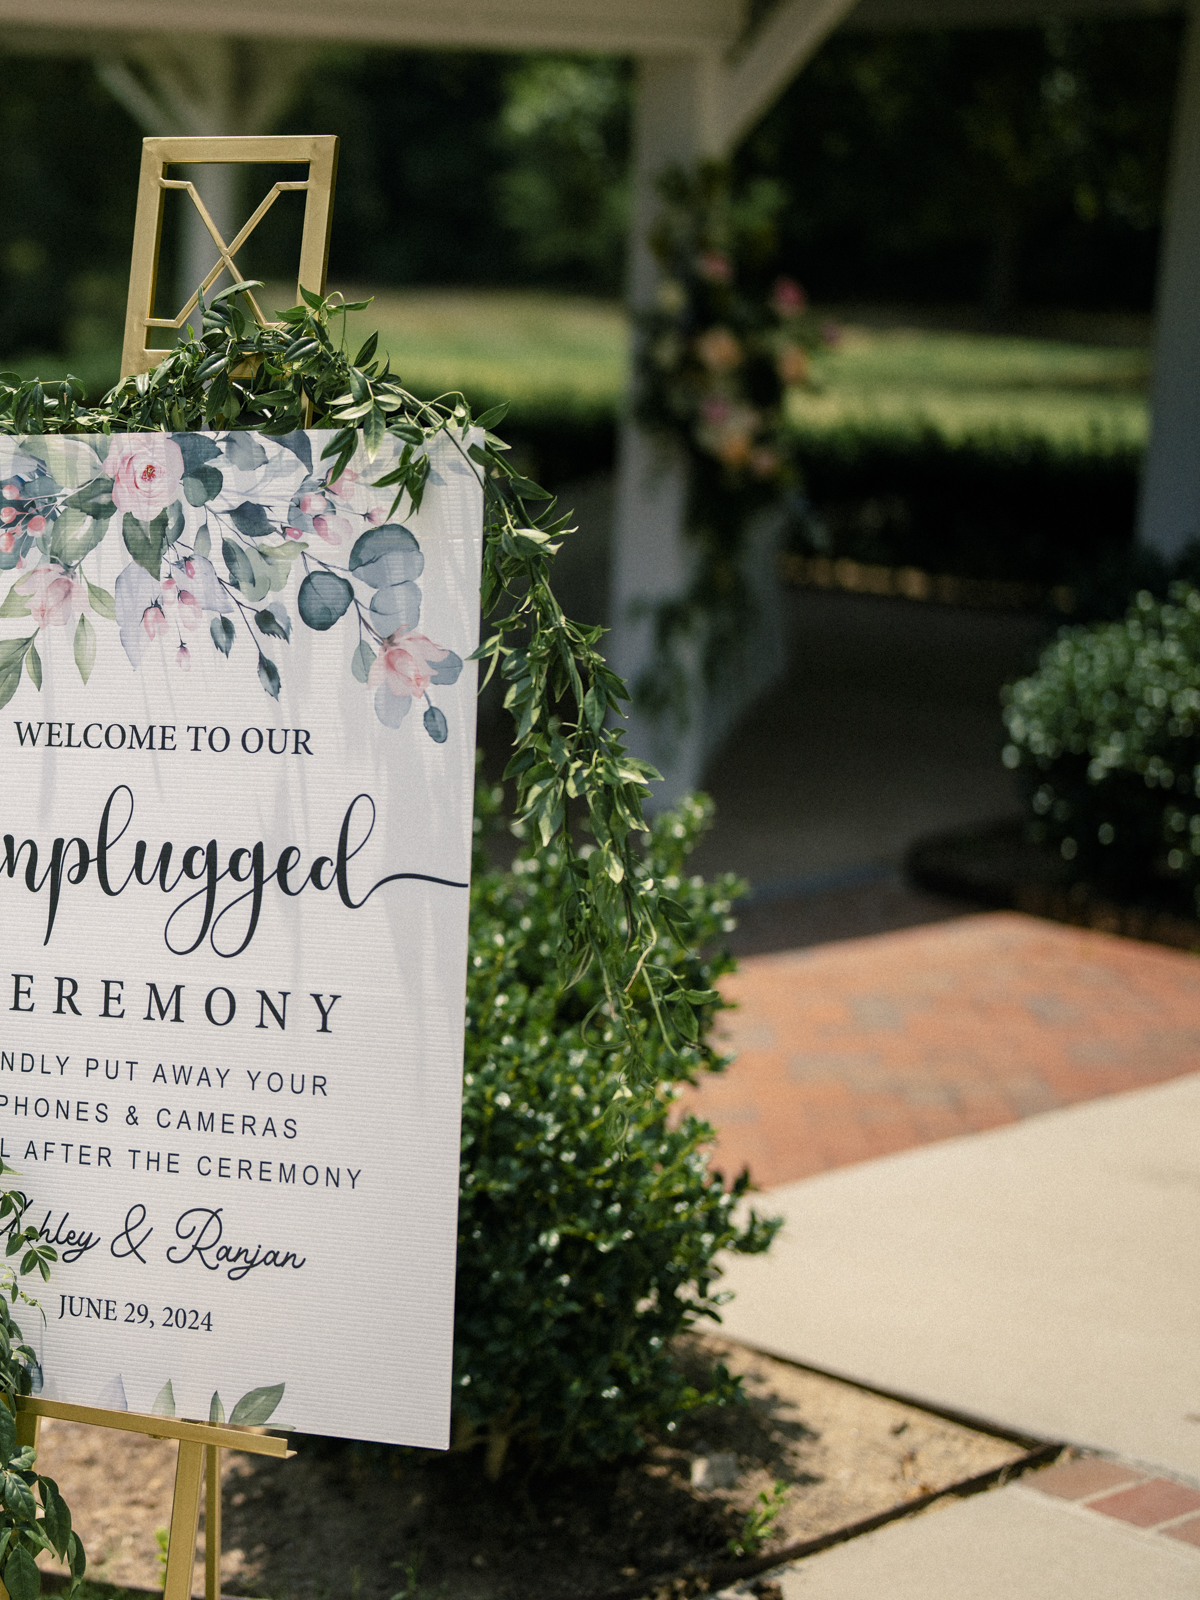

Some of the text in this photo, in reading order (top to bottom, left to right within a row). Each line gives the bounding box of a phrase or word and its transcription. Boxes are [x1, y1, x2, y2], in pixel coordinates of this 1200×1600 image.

[14, 721, 314, 755] WELCOME TO OUR
[86, 1058, 139, 1082] PUT
[153, 1064, 230, 1089] AWAY
[247, 1070, 327, 1096] YOUR
[125, 1105, 139, 1126] &
[156, 1108, 298, 1139] CAMERAS
[24, 1141, 112, 1168] AFTER
[128, 1149, 180, 1174] THE
[197, 1156, 362, 1190] CEREMONY
[110, 1203, 153, 1265] &
[166, 1207, 306, 1281] Ranjan
[59, 1294, 213, 1332] JUNE 29, 2024
